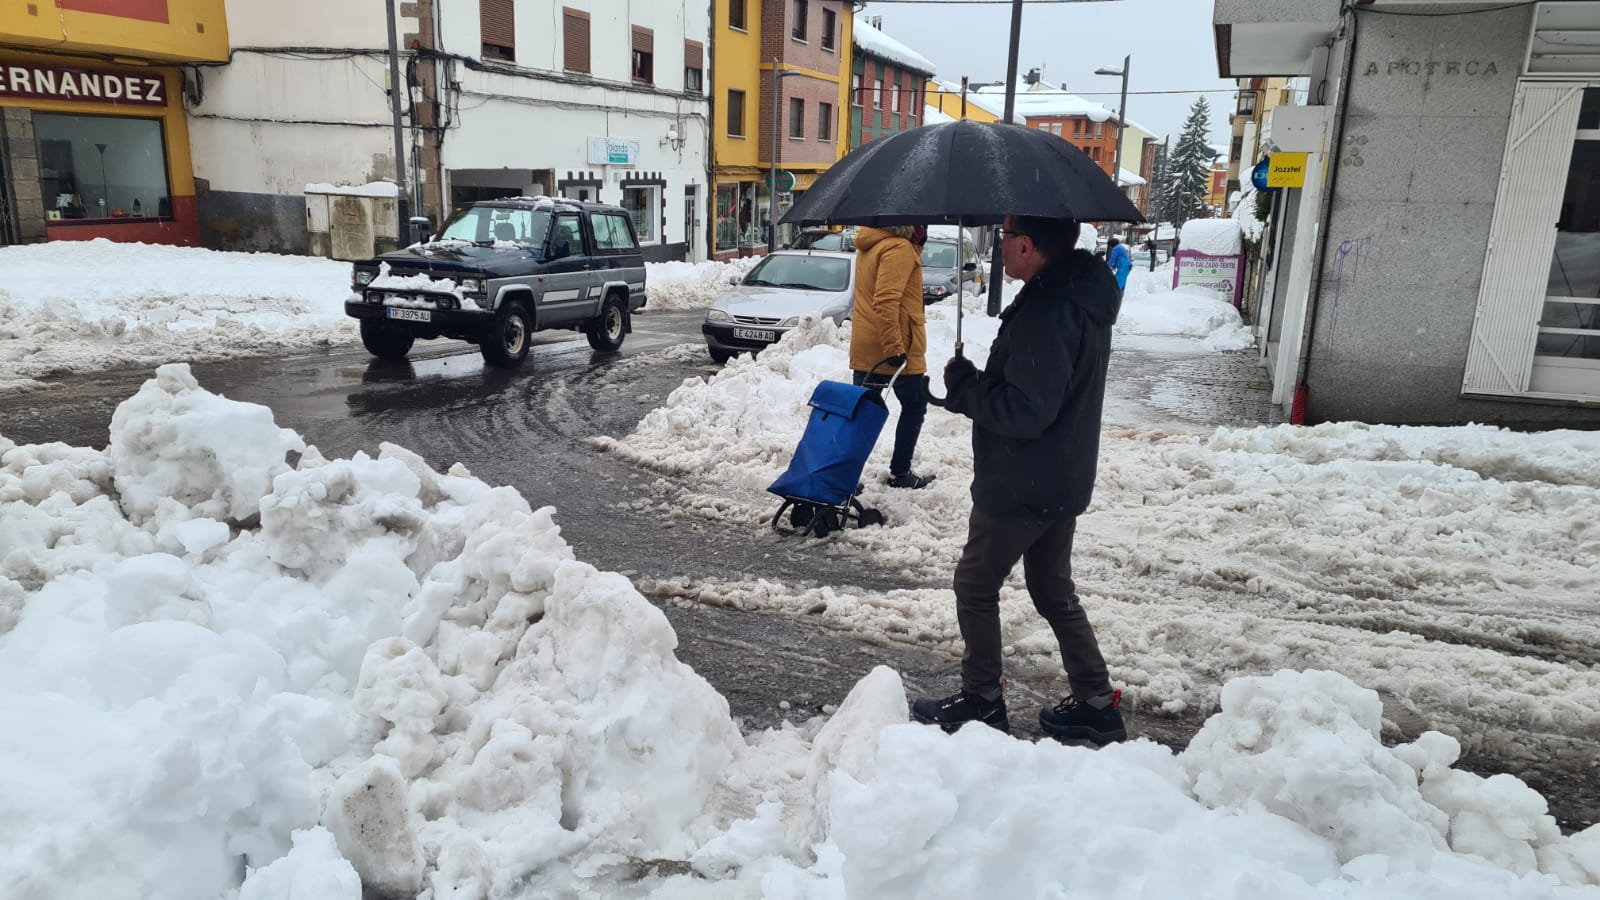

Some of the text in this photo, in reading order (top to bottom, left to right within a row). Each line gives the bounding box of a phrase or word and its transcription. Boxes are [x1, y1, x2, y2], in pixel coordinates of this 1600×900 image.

[1363, 61, 1498, 76] APOTECA
[0, 66, 162, 102] RNANDEZ
[1273, 165, 1302, 173] Jazztel
[401, 310, 419, 320] 3975
[735, 328, 743, 338] LE
[744, 330, 763, 339] 4248
